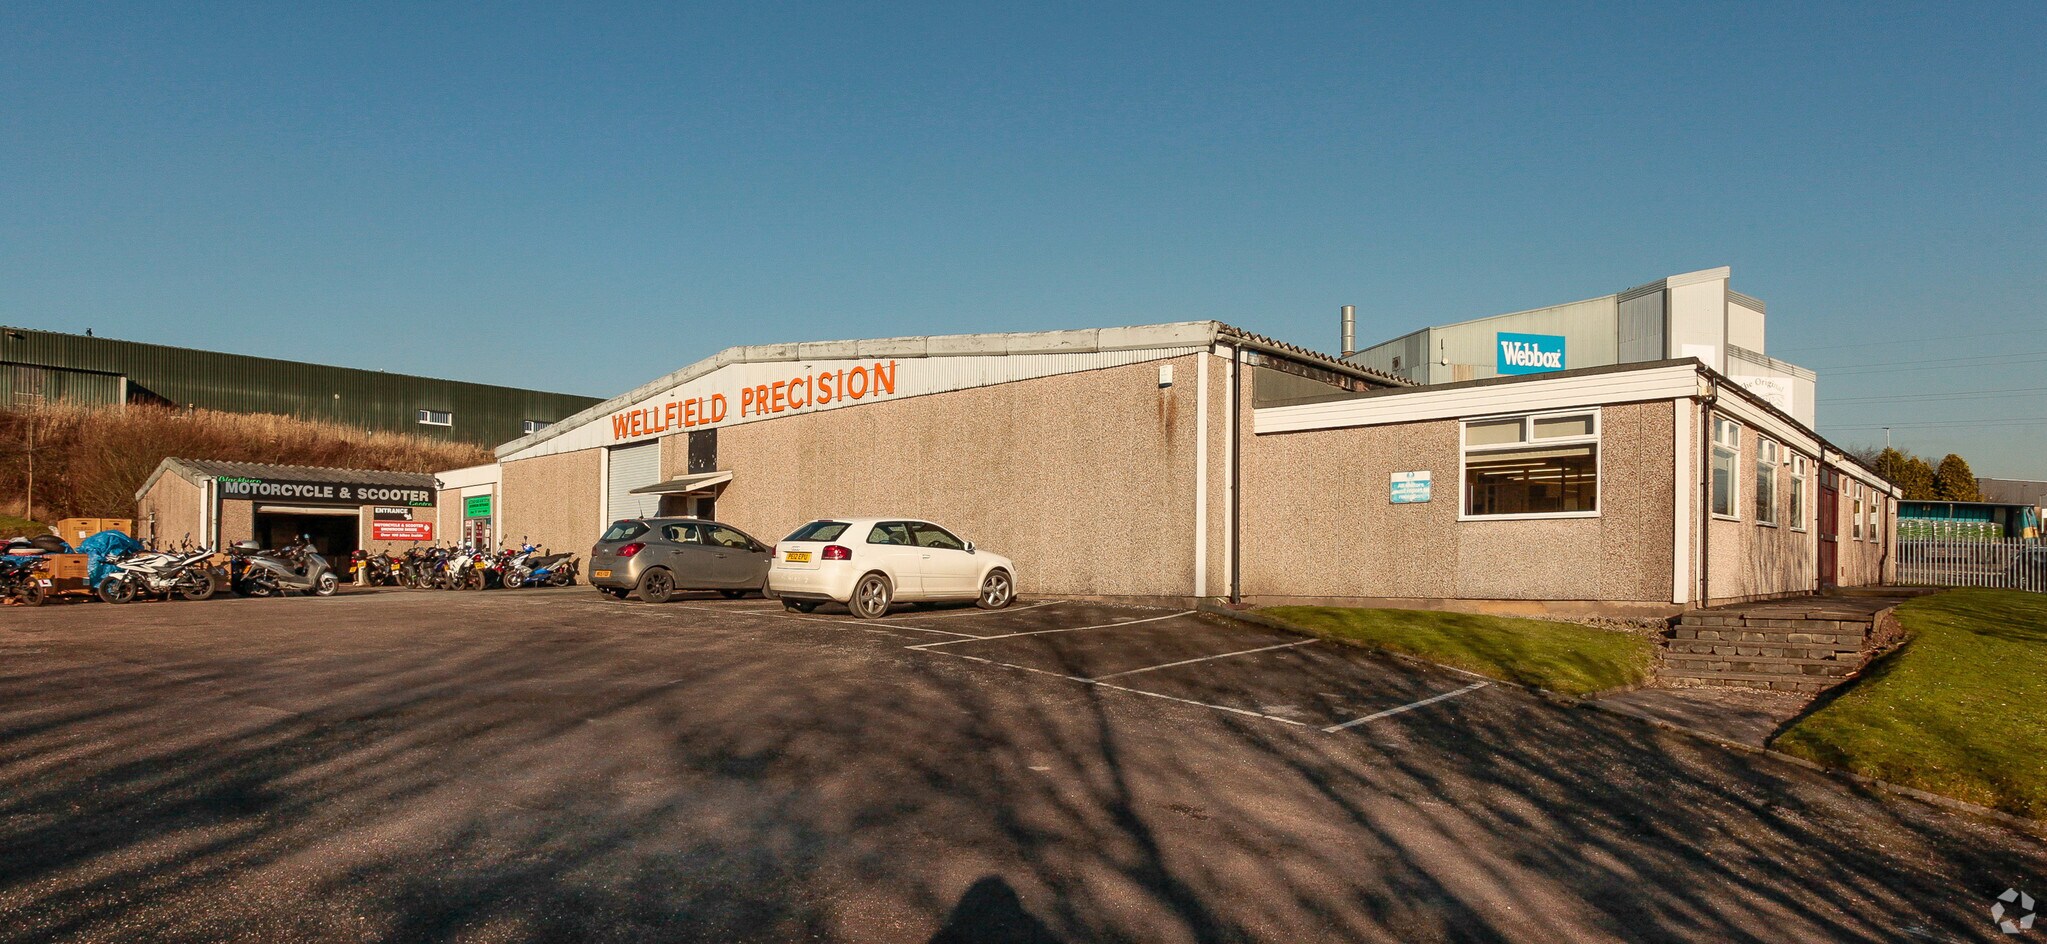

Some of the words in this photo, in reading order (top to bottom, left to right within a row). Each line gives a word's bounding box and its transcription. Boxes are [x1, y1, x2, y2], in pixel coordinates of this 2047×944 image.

[1501, 341, 1561, 368] Webbox
[612, 393, 727, 440] WELLFIELD
[741, 360, 896, 417] PRECISION
[225, 481, 333, 498] MOTORCYCLE
[339, 488, 351, 499] &
[357, 488, 429, 501] SCOOTER
